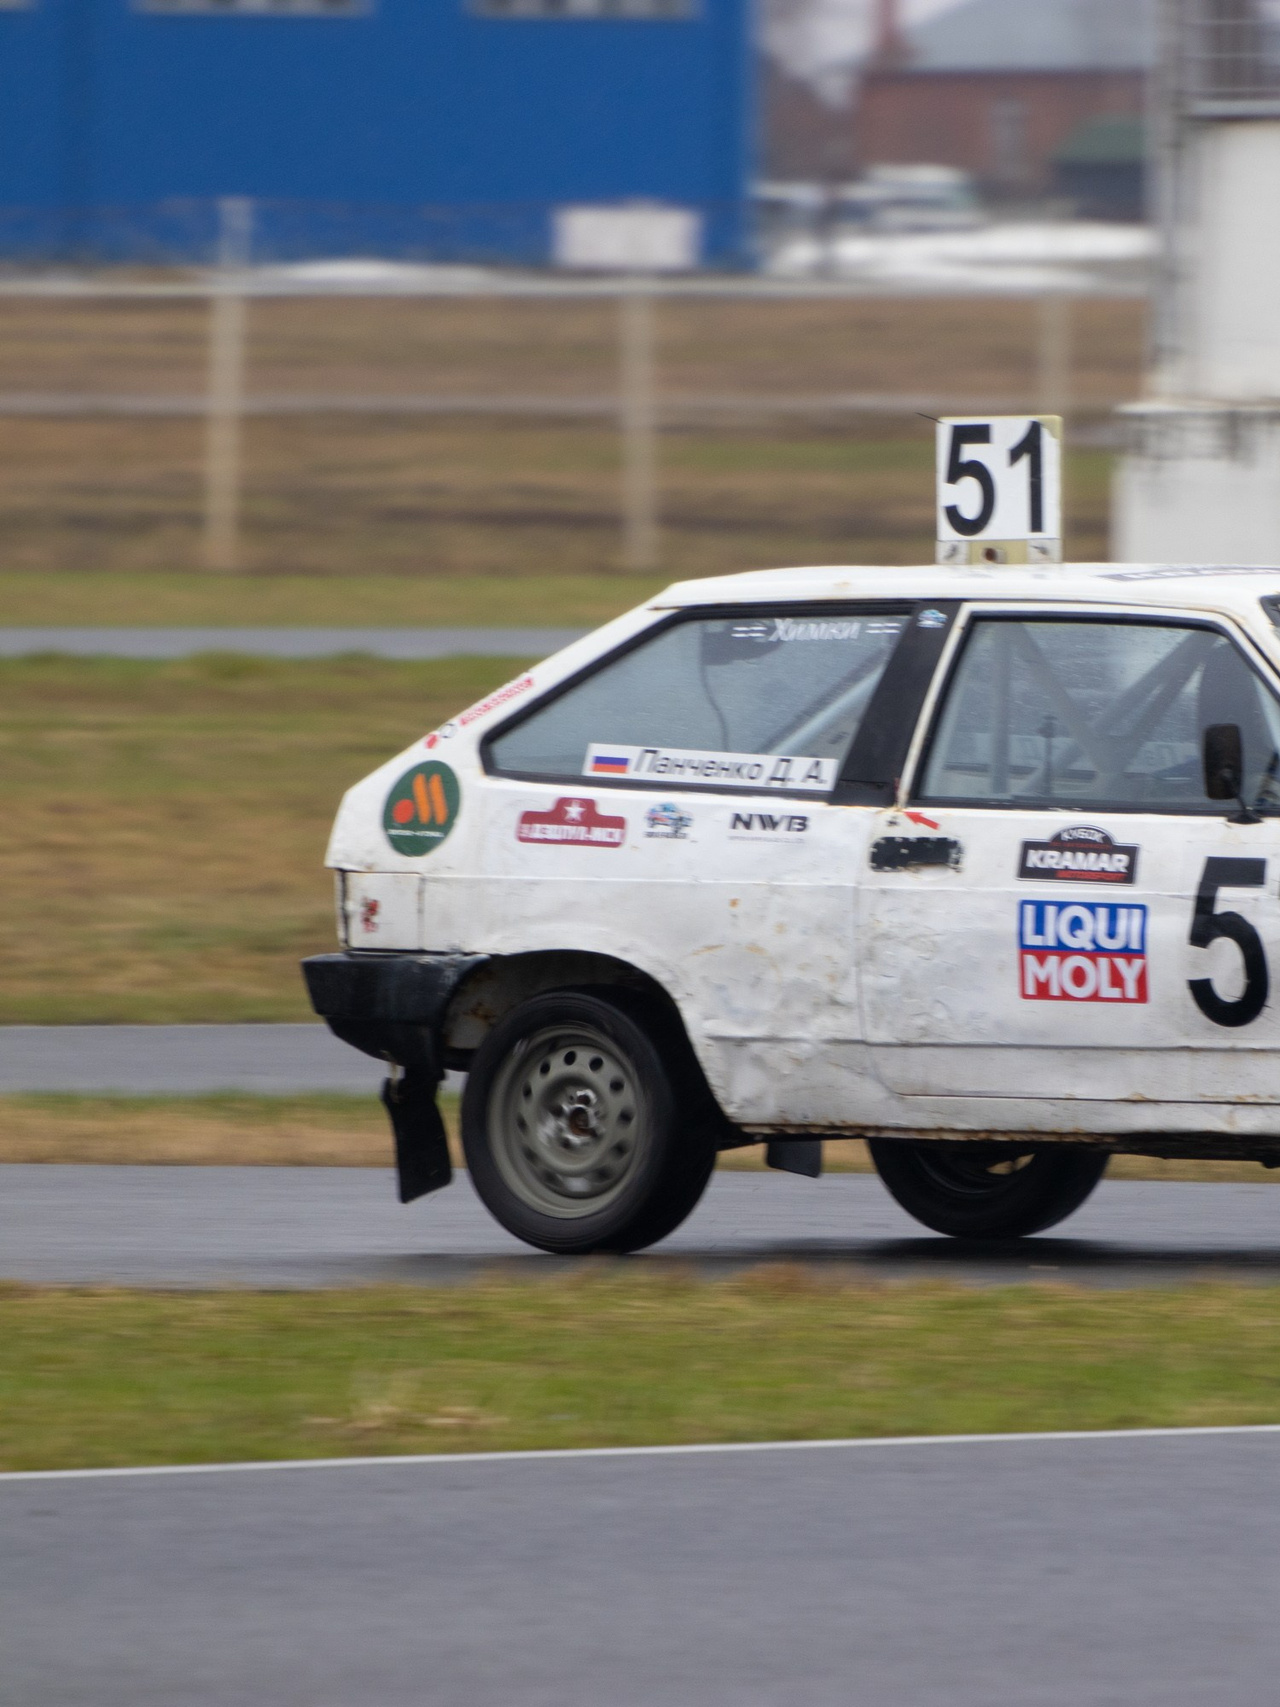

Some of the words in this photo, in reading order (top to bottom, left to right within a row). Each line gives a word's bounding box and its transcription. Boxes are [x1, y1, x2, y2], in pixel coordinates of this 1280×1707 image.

[945, 421, 1042, 537] 51
[634, 749, 764, 780] Панченко
[730, 812, 811, 832] NWB
[1024, 849, 1131, 873] KRAMAR
[1022, 904, 1143, 951] LIQUI
[1022, 955, 1146, 999] MOLY
